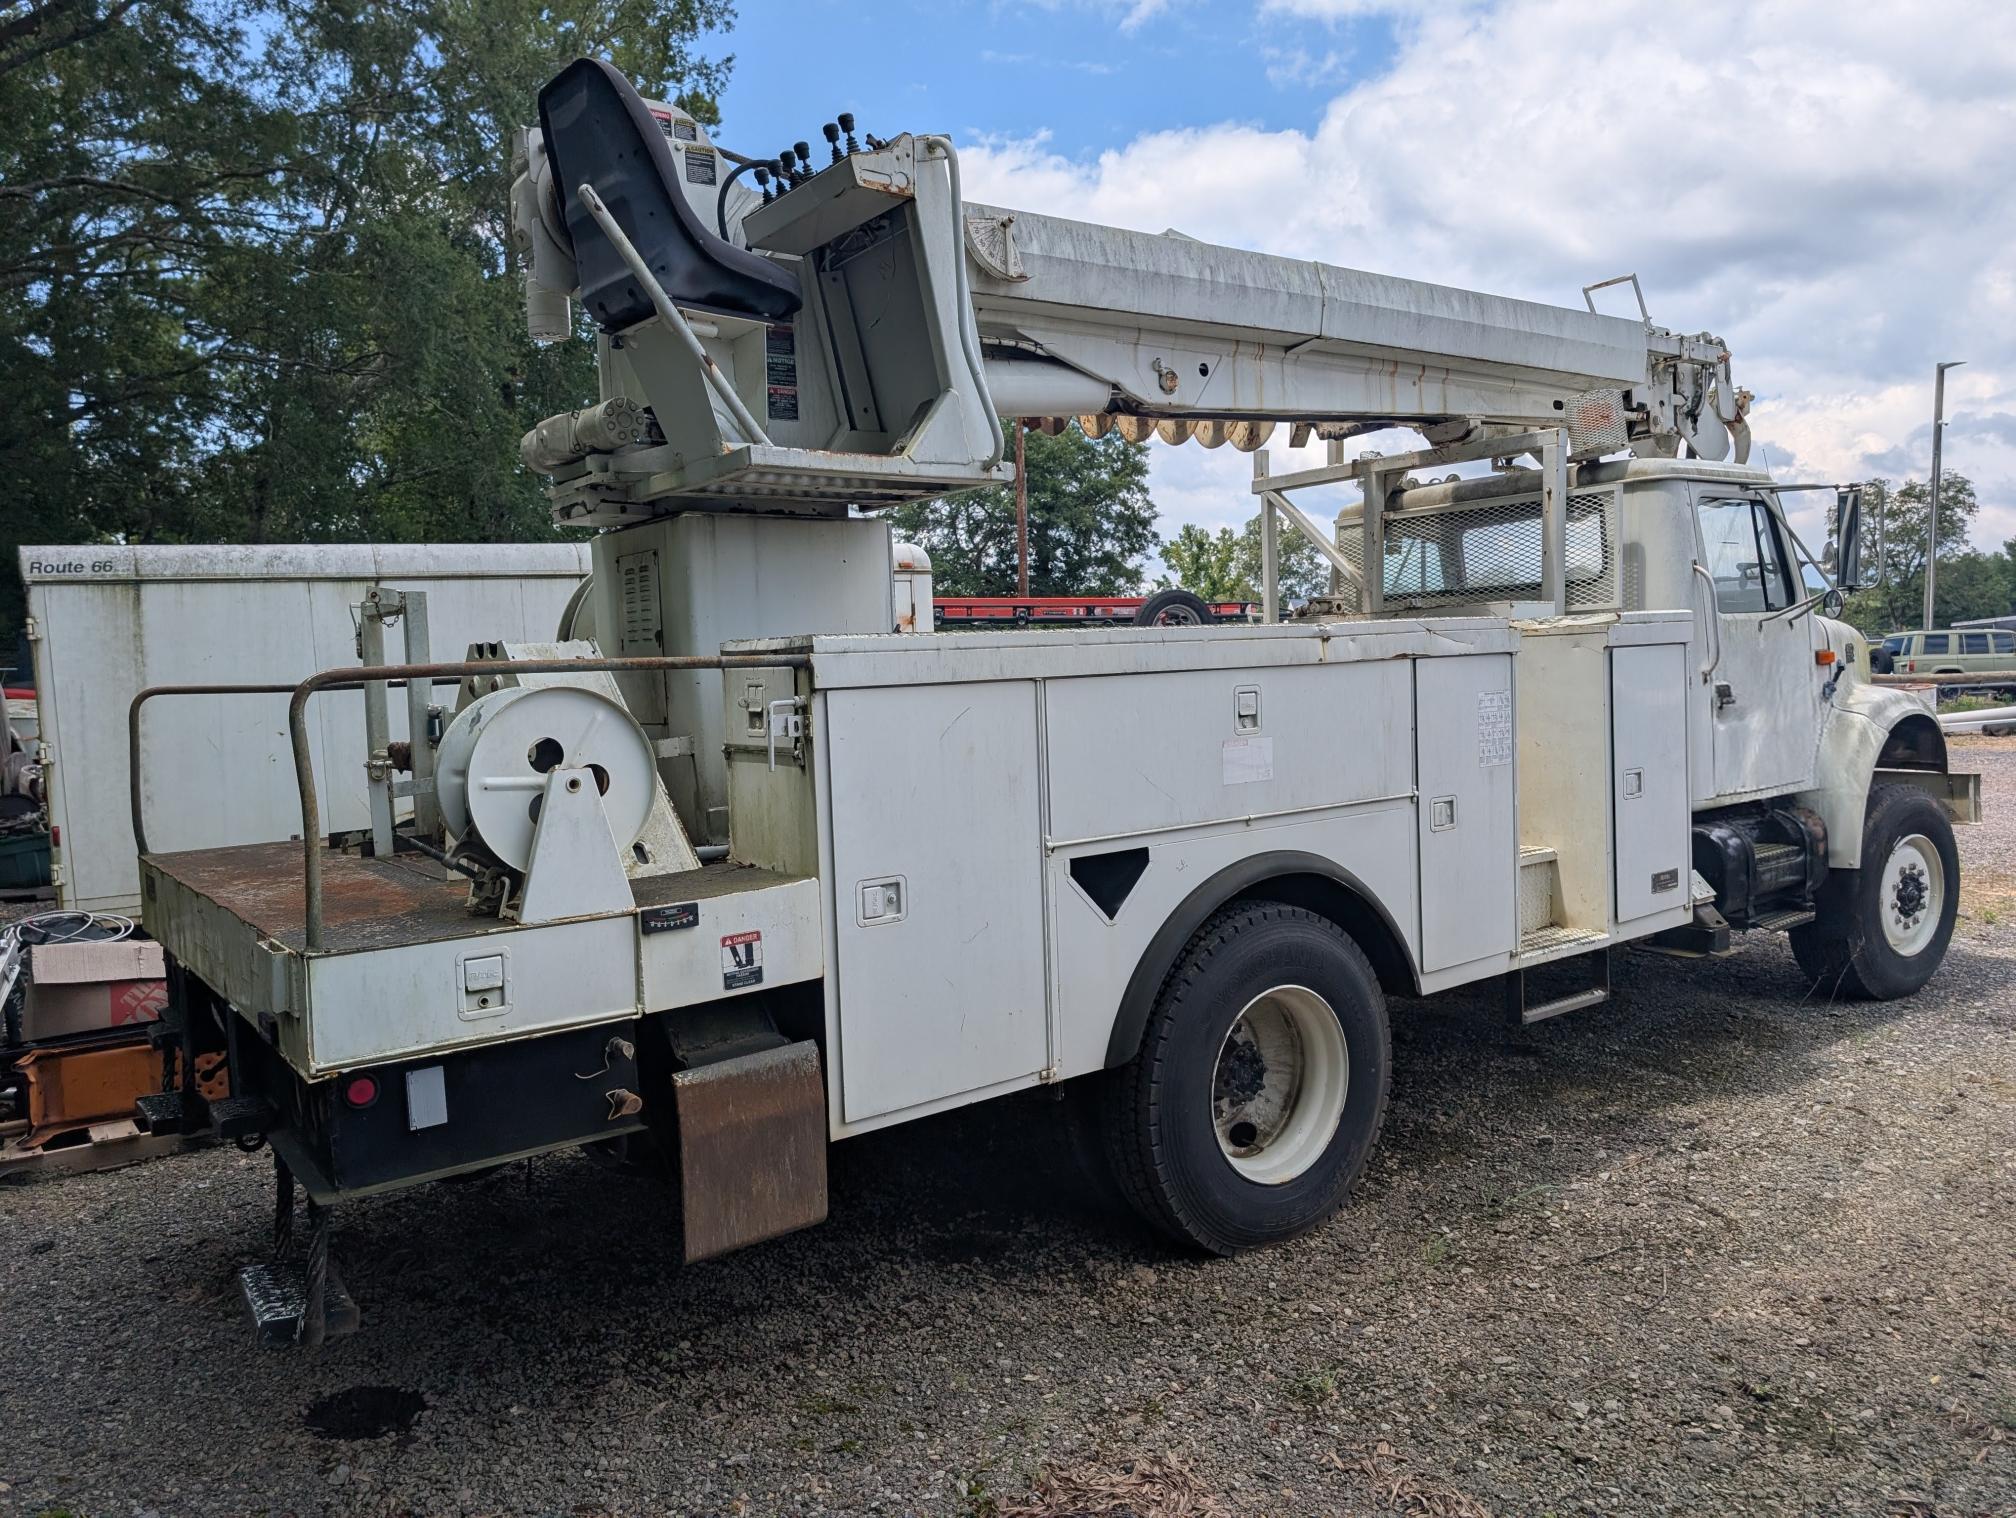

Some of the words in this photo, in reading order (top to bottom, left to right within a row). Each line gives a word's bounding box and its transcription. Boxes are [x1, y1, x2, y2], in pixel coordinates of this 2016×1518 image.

[29, 561, 85, 574] Route
[91, 560, 113, 573] 66
[733, 933, 758, 944] DANGER
